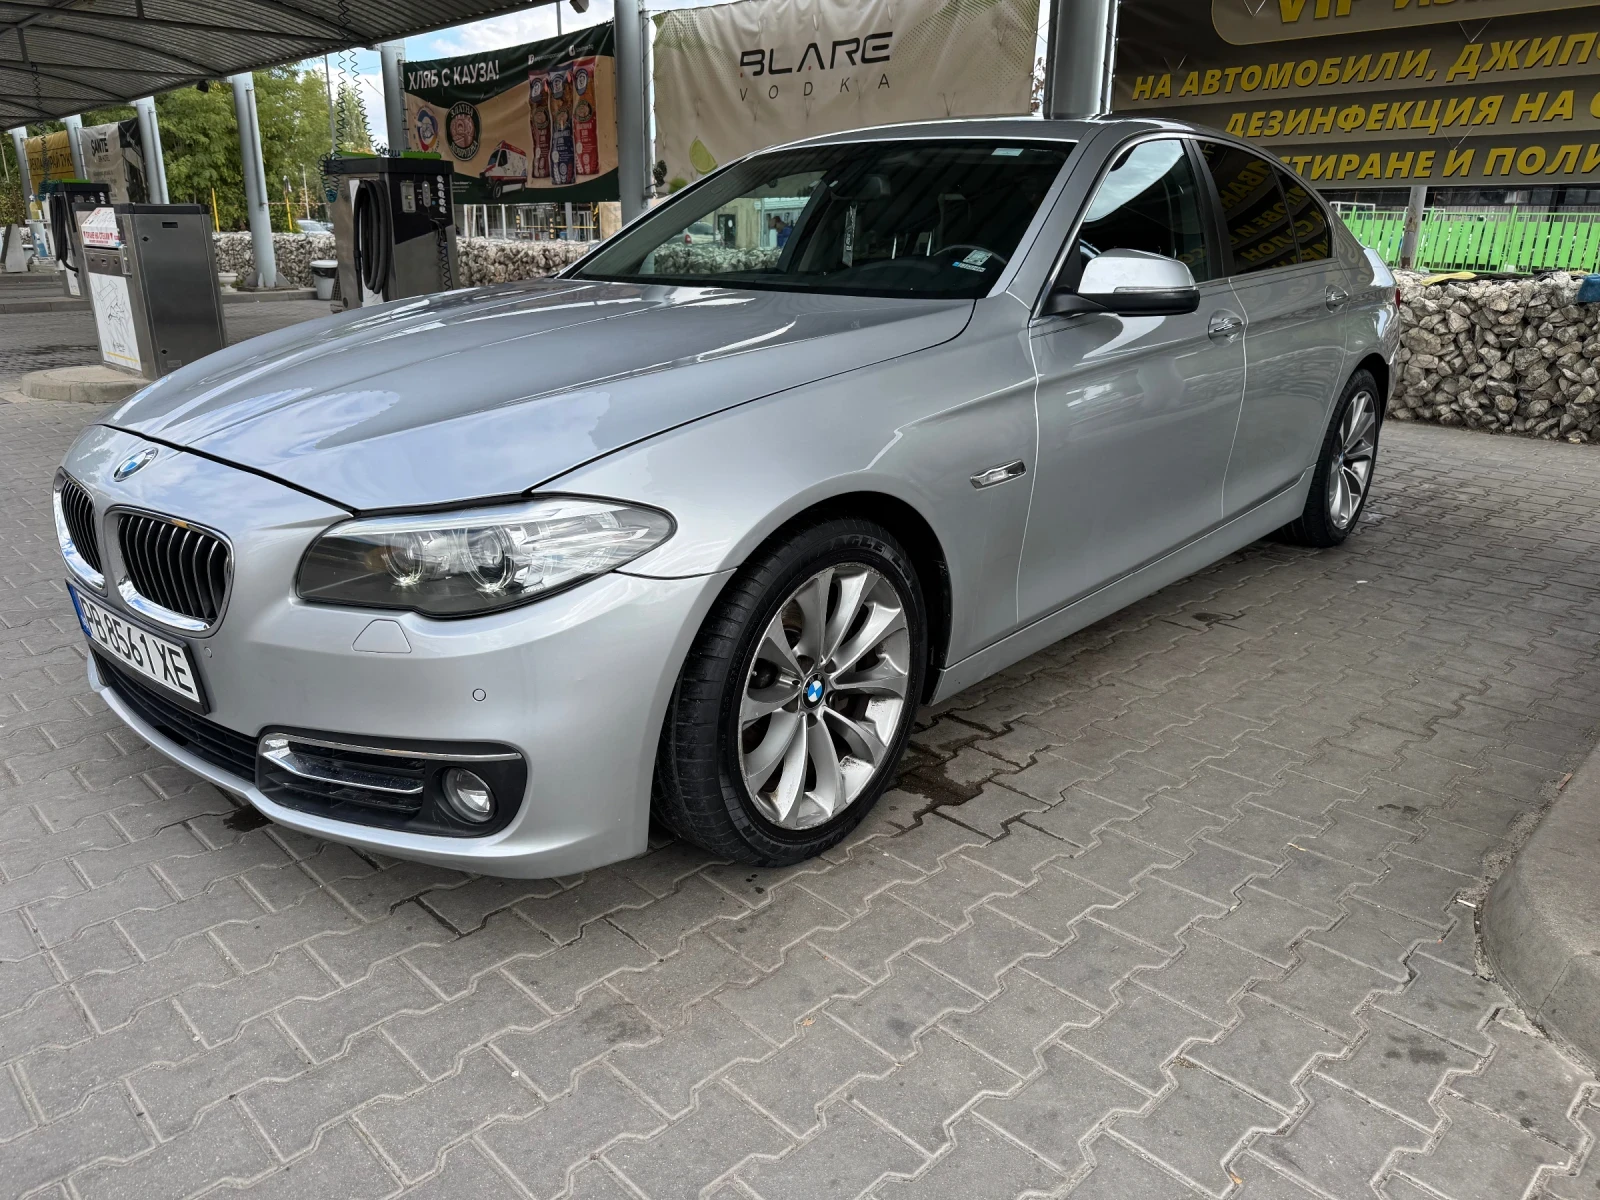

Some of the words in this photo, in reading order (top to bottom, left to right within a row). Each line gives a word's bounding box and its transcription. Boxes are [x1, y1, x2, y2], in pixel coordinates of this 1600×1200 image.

[407, 69, 439, 91] ХЛЯБ
[441, 67, 451, 87] С
[453, 60, 500, 86] КАУЗА!
[739, 31, 893, 78] BLARE
[1131, 73, 1171, 101] НА
[1178, 48, 1438, 98] АВТОМОБИЛИ,
[739, 73, 891, 102] VODKA
[1224, 95, 1504, 138] ДЕЗИНФЕКЦИЯ
[1510, 90, 1574, 123] НА
[1279, 150, 1436, 181] ТИРАНЕ
[1442, 149, 1475, 178] И
[103, 613, 156, 676] 8561
[153, 639, 194, 694] XE
